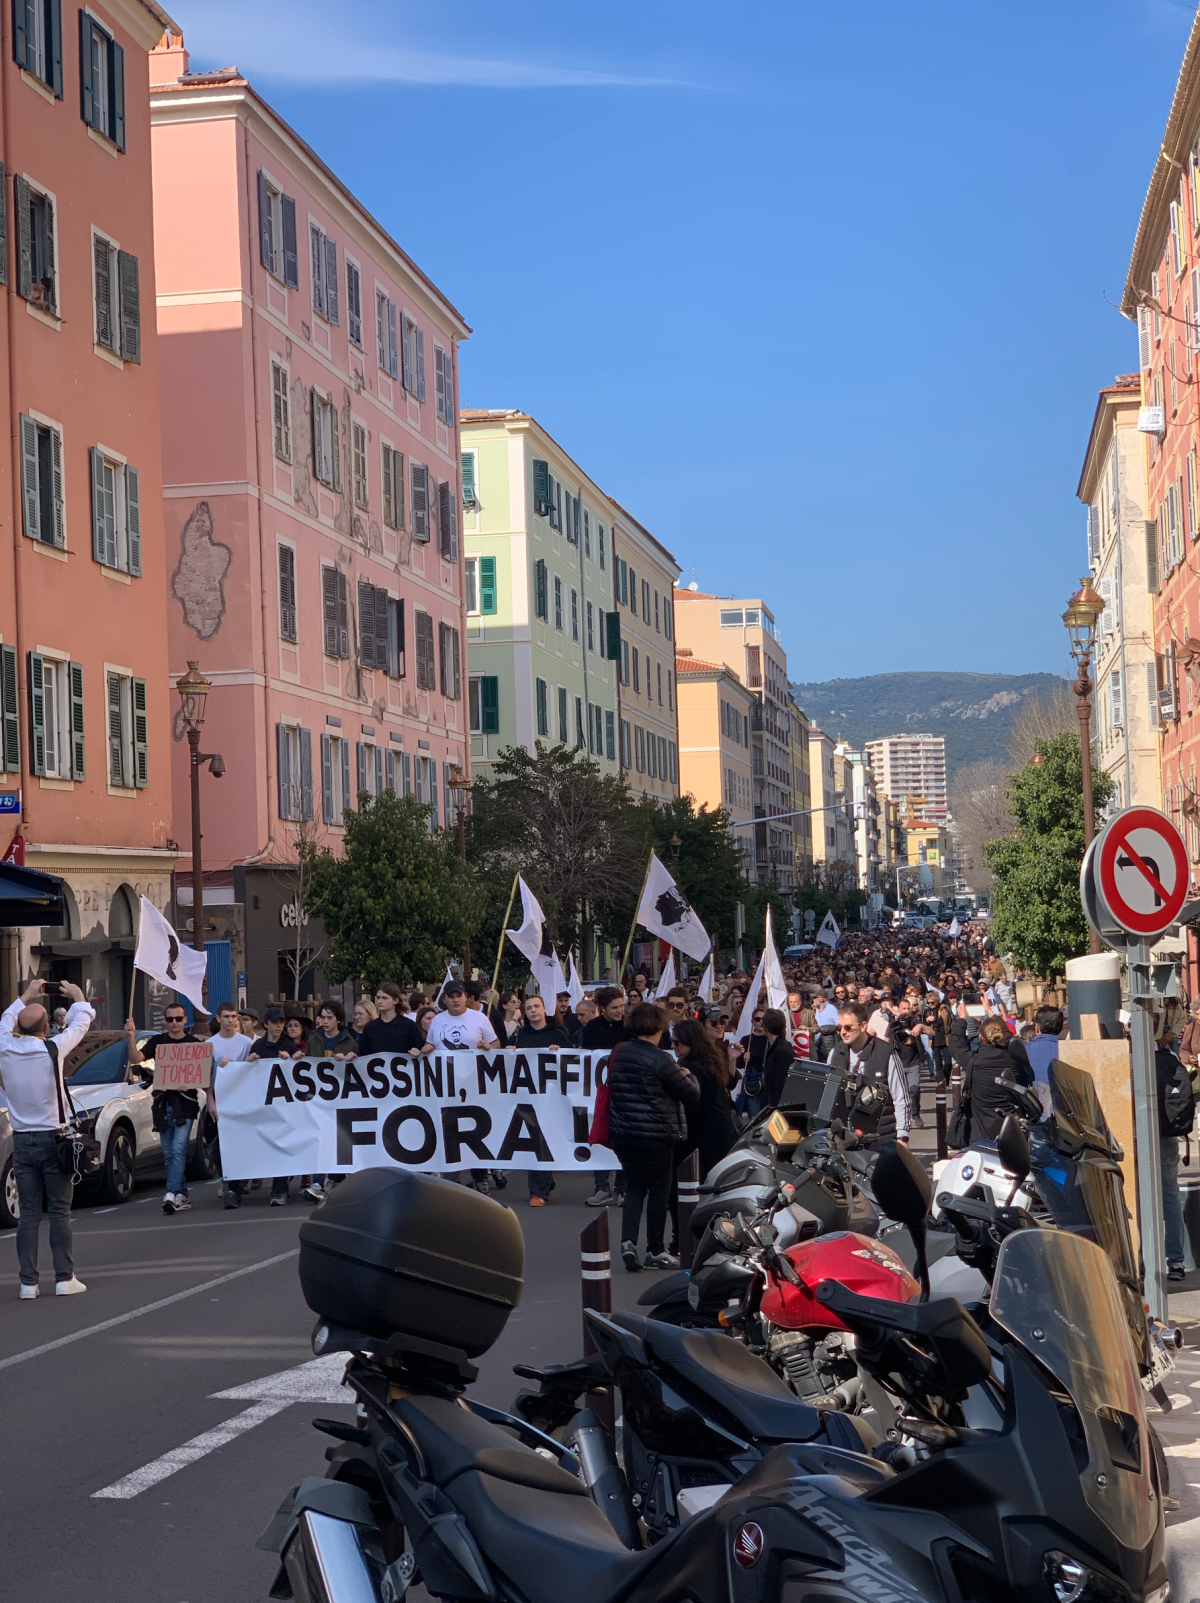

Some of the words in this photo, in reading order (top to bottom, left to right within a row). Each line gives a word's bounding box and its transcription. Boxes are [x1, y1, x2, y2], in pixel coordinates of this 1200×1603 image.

[157, 1046, 166, 1060] U
[160, 1063, 203, 1085] TOMBA
[265, 1055, 467, 1105] ASSASSINI,
[335, 1103, 555, 1166] FORA
[572, 1106, 592, 1162] !
